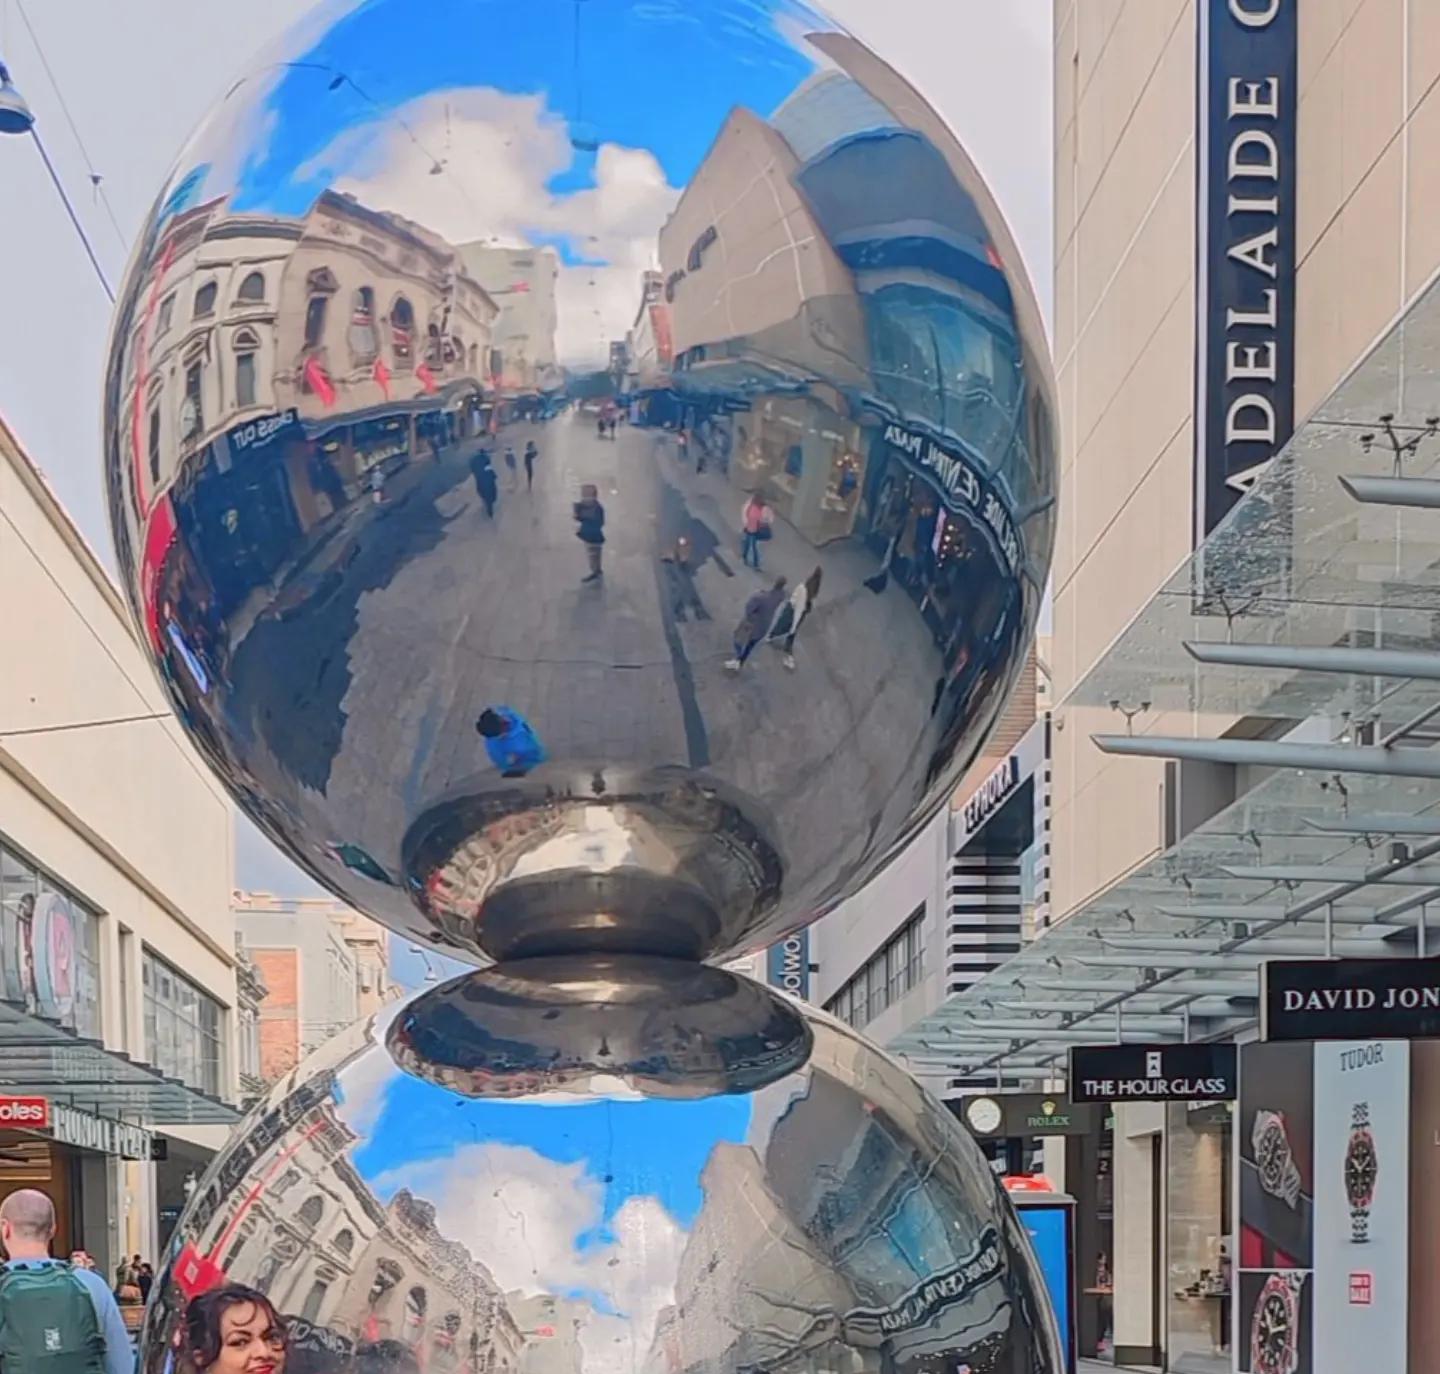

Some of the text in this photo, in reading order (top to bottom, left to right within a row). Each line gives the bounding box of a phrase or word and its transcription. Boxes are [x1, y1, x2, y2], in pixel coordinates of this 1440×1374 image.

[1225, 76, 1279, 500] ADELAIDE
[777, 932, 801, 999] olwo
[1284, 987, 1440, 1011] DAVID JON
[1340, 1043, 1384, 1071] TUDOR
[1083, 1078, 1226, 1096] THE HOUR GLASS
[1027, 1115, 1070, 1128] ROLEX
